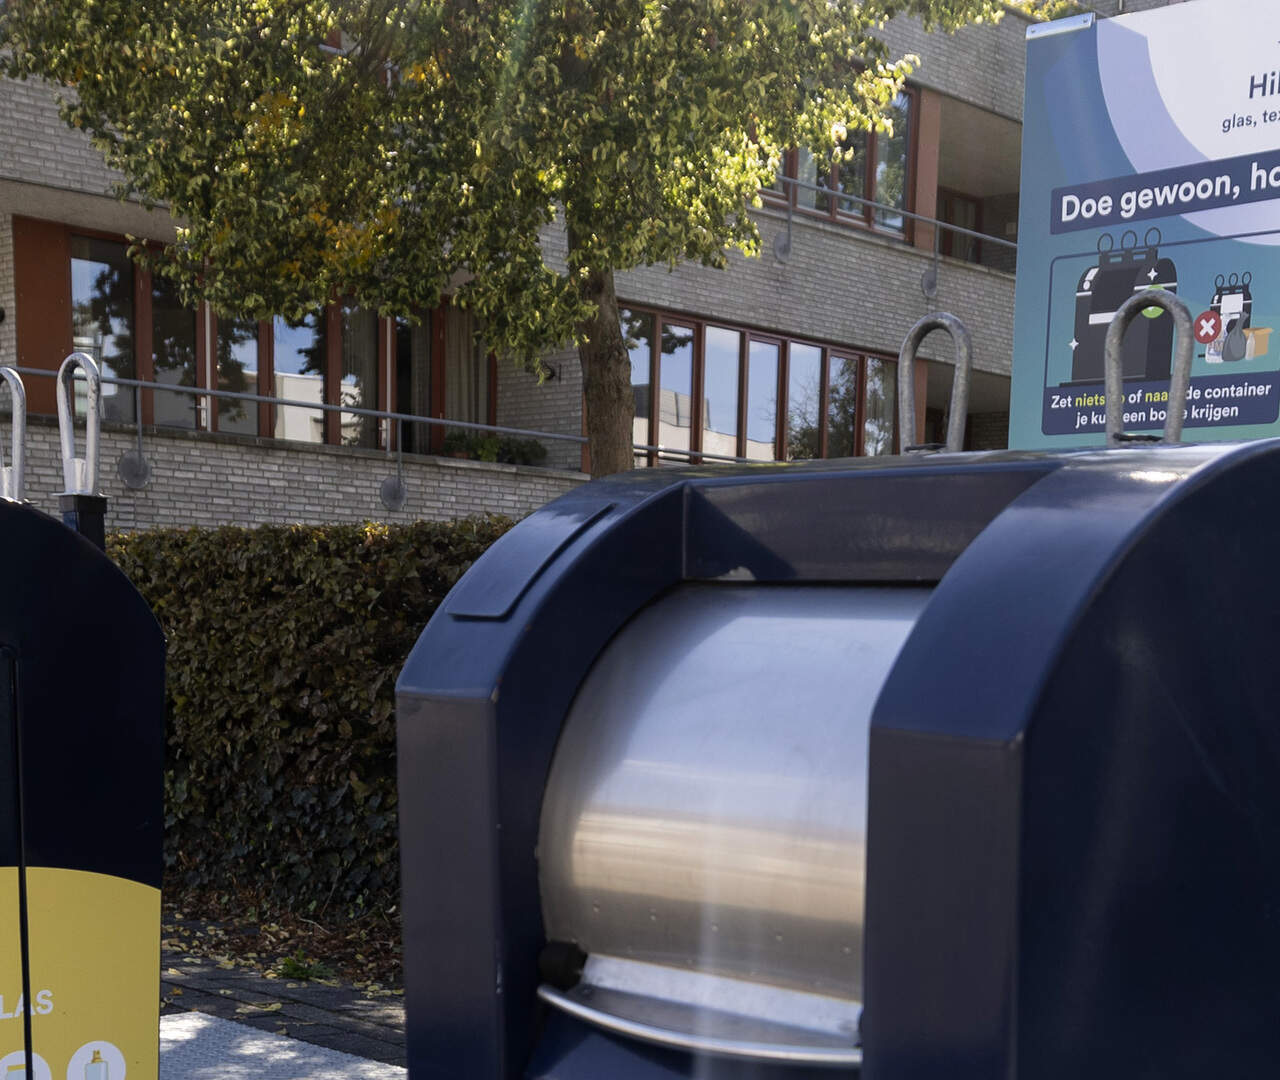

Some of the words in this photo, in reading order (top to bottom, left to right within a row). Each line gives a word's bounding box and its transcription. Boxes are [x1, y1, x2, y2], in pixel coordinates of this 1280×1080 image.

[1222, 112, 1257, 133] glas,
[1061, 194, 1112, 222] Doe
[1120, 173, 1241, 218] gewoon,
[1051, 394, 1073, 409] Zet
[1075, 393, 1106, 407] niets
[1128, 389, 1142, 404] of
[1186, 385, 1201, 400] de
[1204, 382, 1272, 399] container
[1075, 411, 1088, 428] je
[1122, 410, 1146, 423] een
[1191, 403, 1239, 422] krijgen
